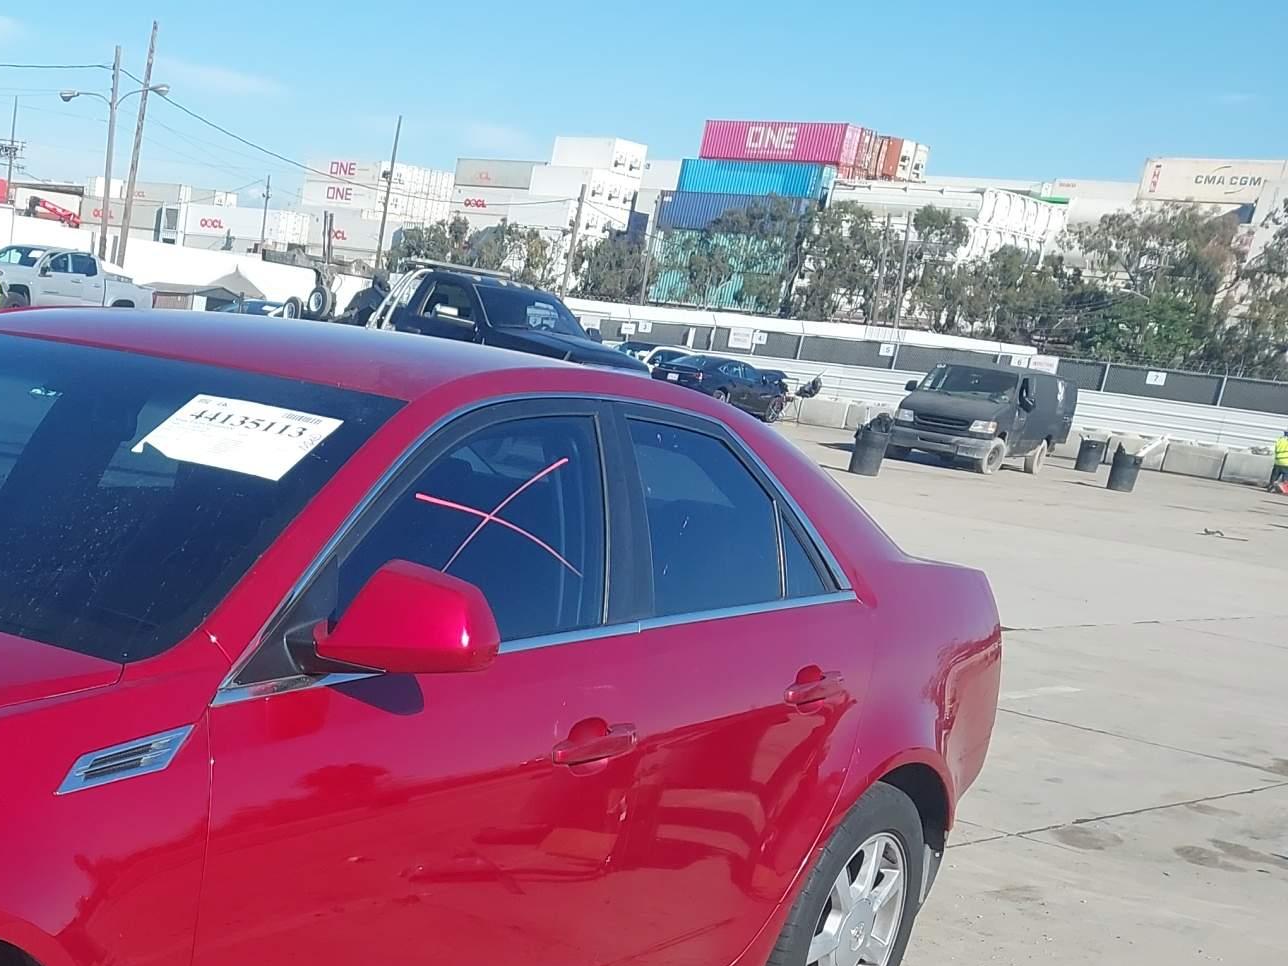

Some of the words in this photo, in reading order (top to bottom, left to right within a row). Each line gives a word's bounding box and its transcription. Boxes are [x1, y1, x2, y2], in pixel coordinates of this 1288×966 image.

[745, 126, 797, 149] ONE
[330, 161, 357, 176] ONE
[1194, 175, 1225, 185] CMA
[1229, 176, 1262, 186] CGM
[326, 186, 353, 201] ONE
[200, 218, 224, 229] OOCL
[189, 409, 308, 438] 44135113
